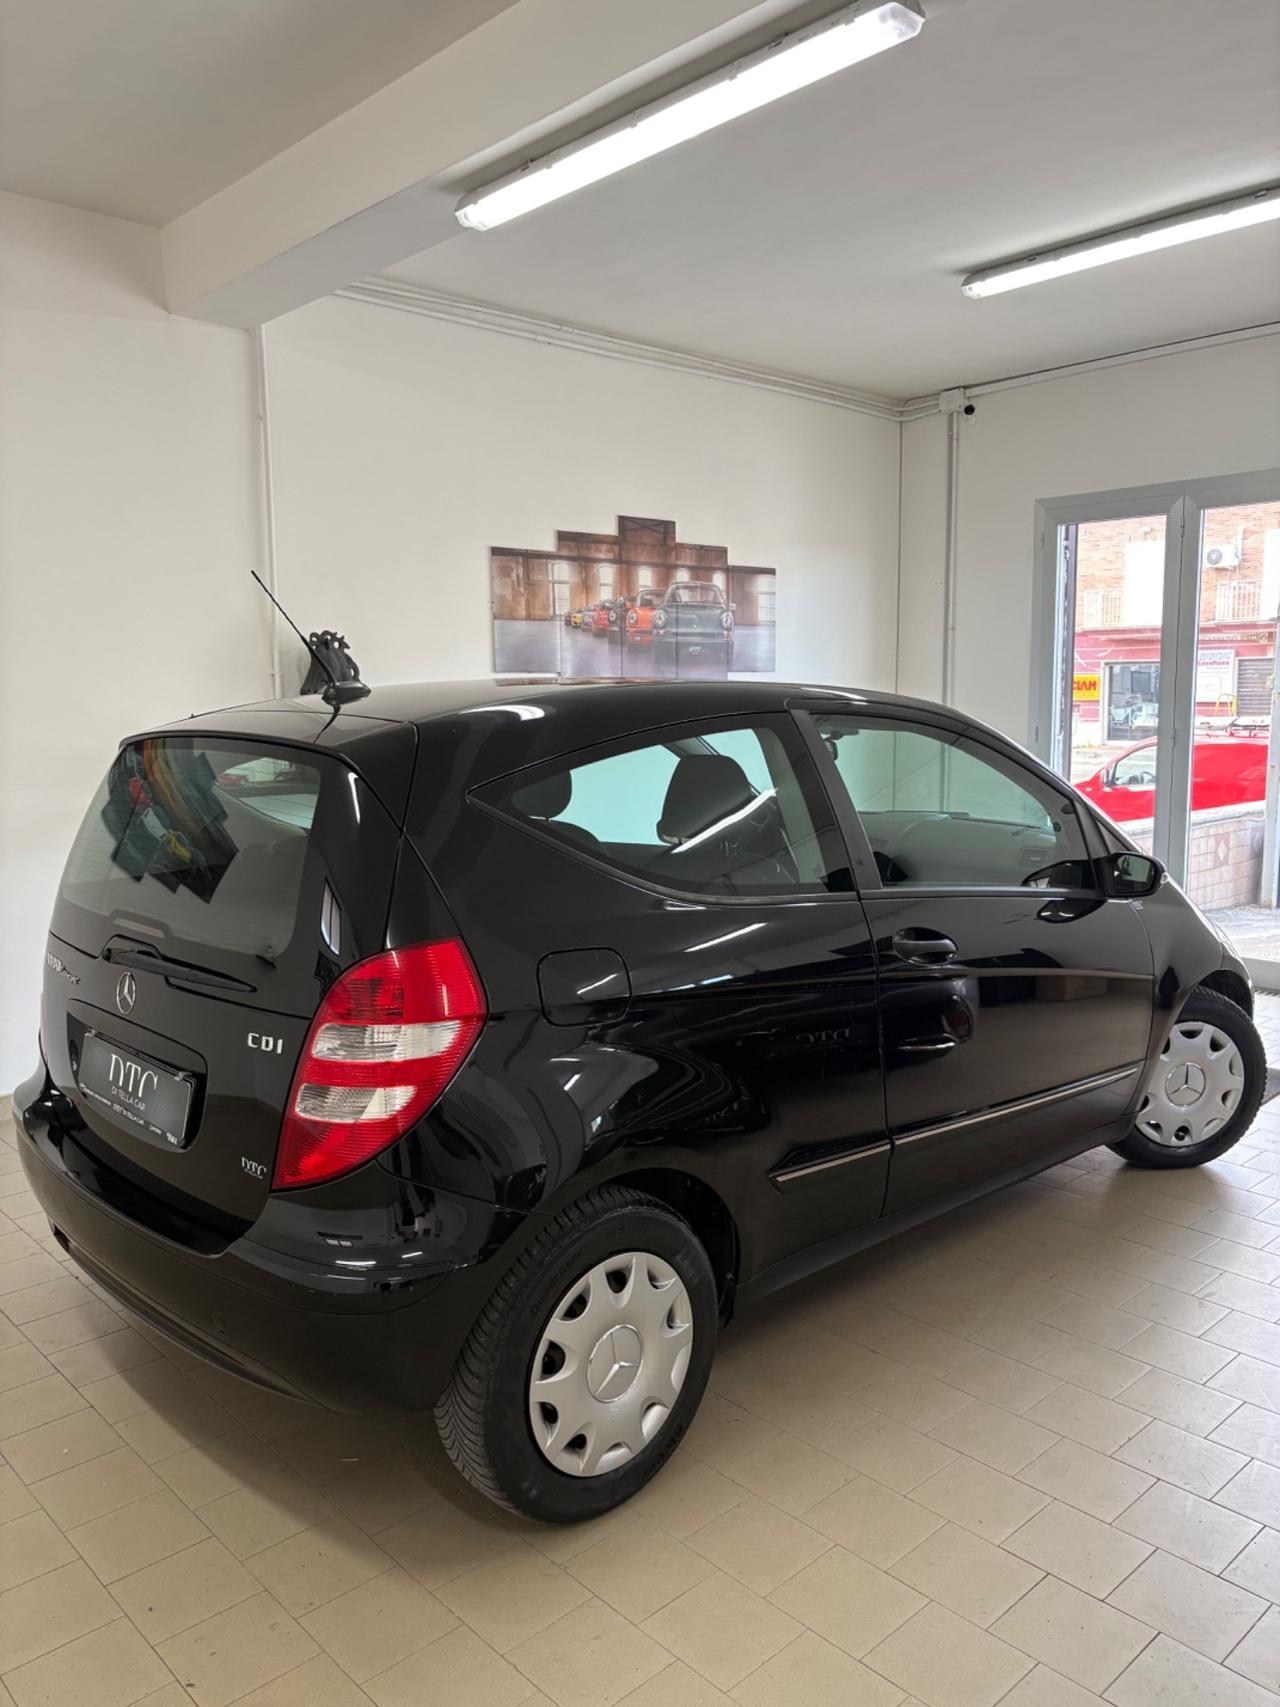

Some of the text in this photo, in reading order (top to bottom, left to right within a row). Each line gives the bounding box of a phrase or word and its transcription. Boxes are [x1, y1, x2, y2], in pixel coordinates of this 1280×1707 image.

[247, 1032, 283, 1055] CDI
[109, 1053, 158, 1097] DTC
[118, 1088, 134, 1105] TELLA
[133, 1100, 146, 1112] CAR
[241, 1156, 267, 1175] DTC
